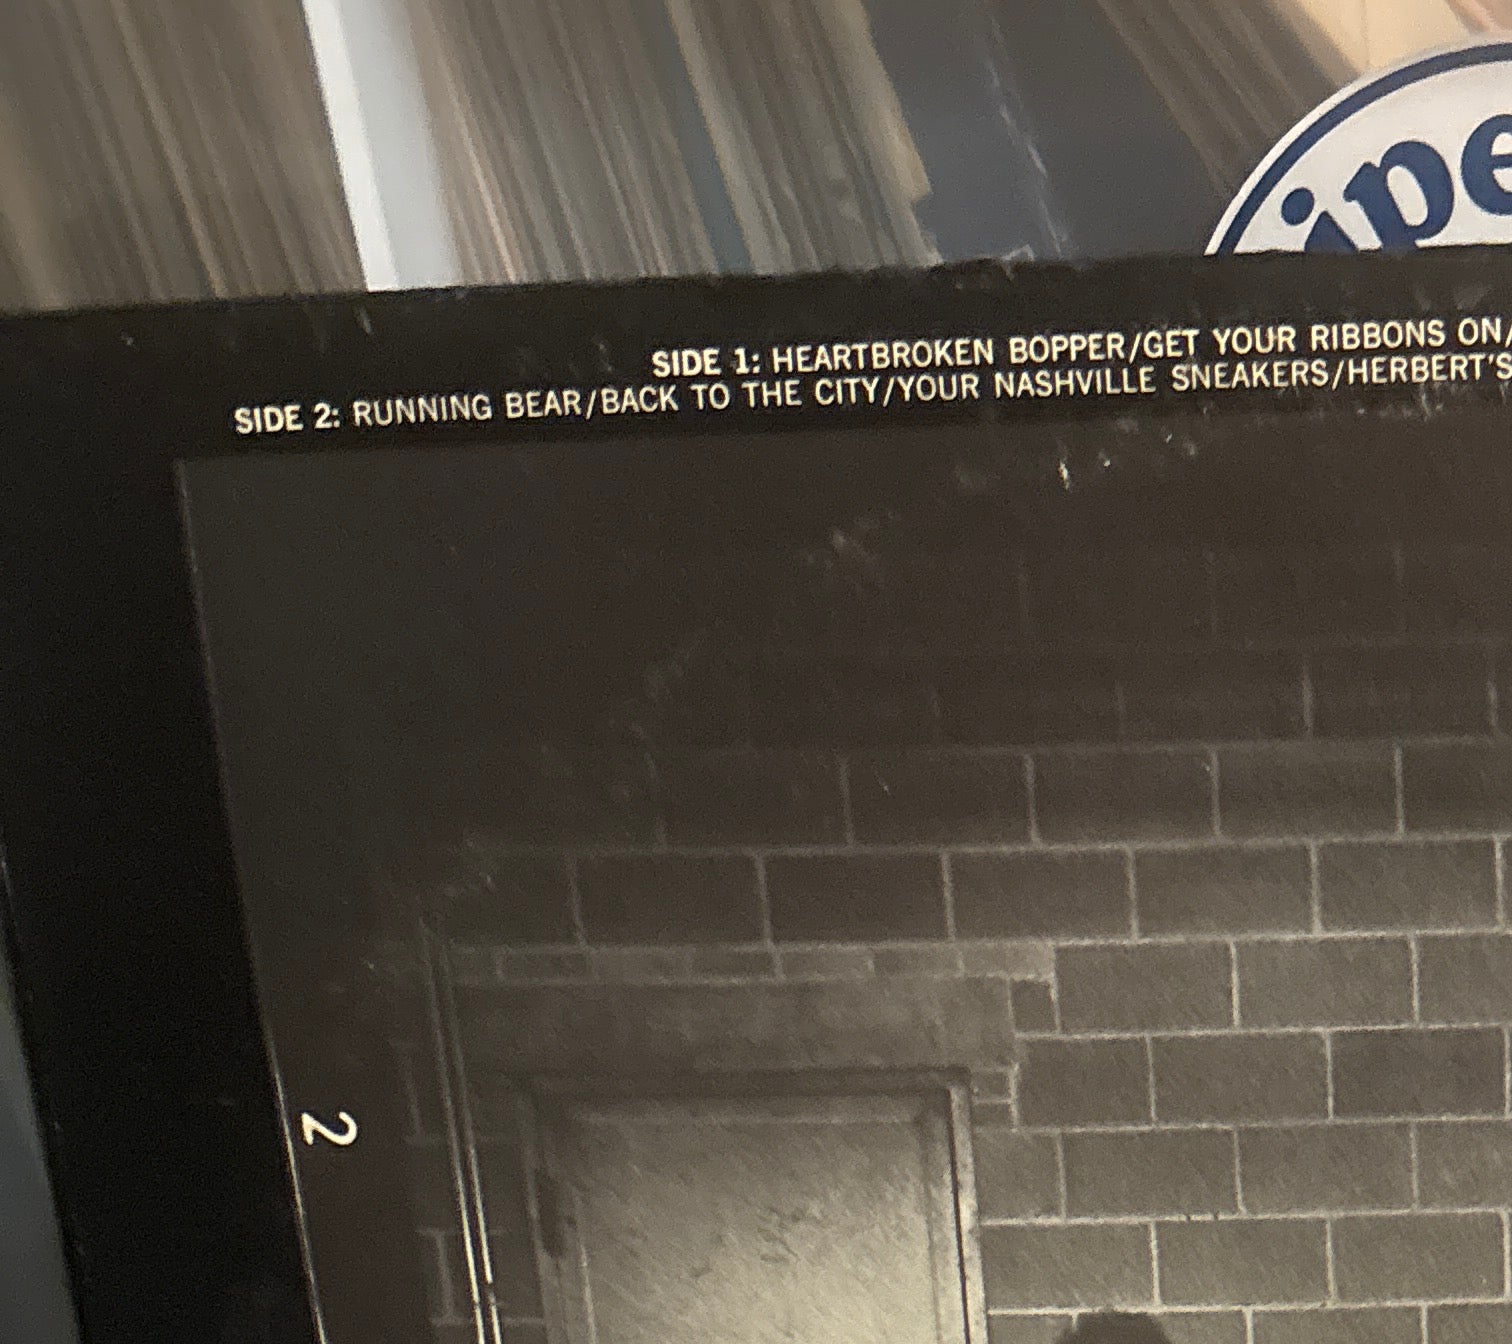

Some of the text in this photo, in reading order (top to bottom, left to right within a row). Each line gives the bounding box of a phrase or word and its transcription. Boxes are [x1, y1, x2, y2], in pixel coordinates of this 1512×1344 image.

[651, 346, 723, 378] SIDE
[733, 346, 761, 375] 1:
[771, 337, 994, 374] HEARTBROKEN
[1008, 326, 1201, 364] BOPPER/GET
[1211, 323, 1297, 356] YOUR
[1310, 318, 1447, 352] RIBBONS
[233, 403, 304, 435] SIDE
[313, 400, 341, 429] 2:
[352, 393, 493, 427] RUNNING
[504, 384, 680, 420] BEAR/BACK
[689, 380, 731, 410] TO
[740, 378, 803, 408] THE
[814, 372, 980, 408] CITY/YOUR
[994, 365, 1157, 399] NASHVILLE
[301, 1111, 358, 1146] 2
